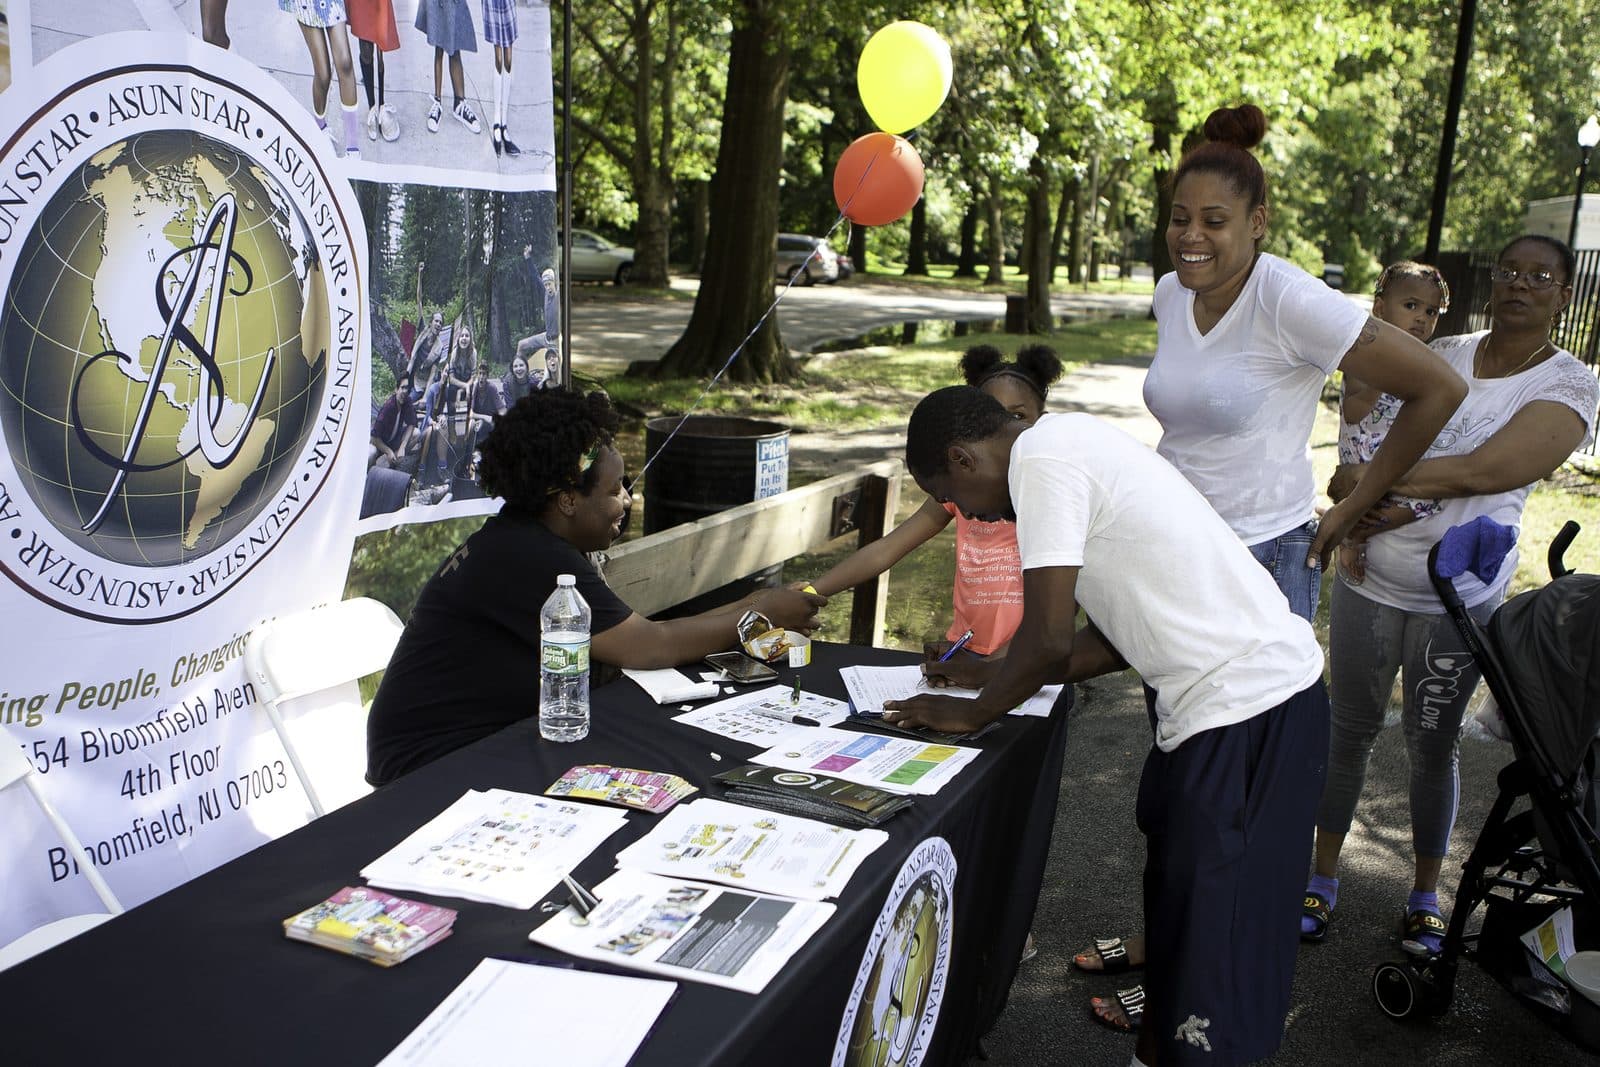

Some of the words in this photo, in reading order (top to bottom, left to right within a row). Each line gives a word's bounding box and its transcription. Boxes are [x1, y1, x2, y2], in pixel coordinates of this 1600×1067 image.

[107, 84, 184, 127] ASUN
[190, 87, 251, 140] STAR
[0, 180, 29, 244] UN
[15, 112, 92, 195] STAR
[263, 135, 322, 208] ASUN
[314, 203, 348, 285] STAR
[335, 305, 354, 392] ASUN
[307, 393, 346, 469] STAR
[761, 463, 776, 474] Put
[250, 481, 300, 555] ASUN
[18, 530, 95, 596] STAR
[88, 575, 175, 609] ASUN
[189, 543, 247, 596] STAR
[0, 692, 50, 728] ing
[54, 667, 161, 714] People,
[24, 736, 70, 775] 54
[80, 695, 208, 764] Bloomfield
[213, 682, 257, 720] Aven
[1421, 695, 1452, 730] LOVE
[120, 763, 162, 800] 4th
[169, 744, 222, 785] Floor
[198, 788, 221, 825] NJ
[226, 760, 288, 811] 07003
[922, 973, 944, 1026] STAR
